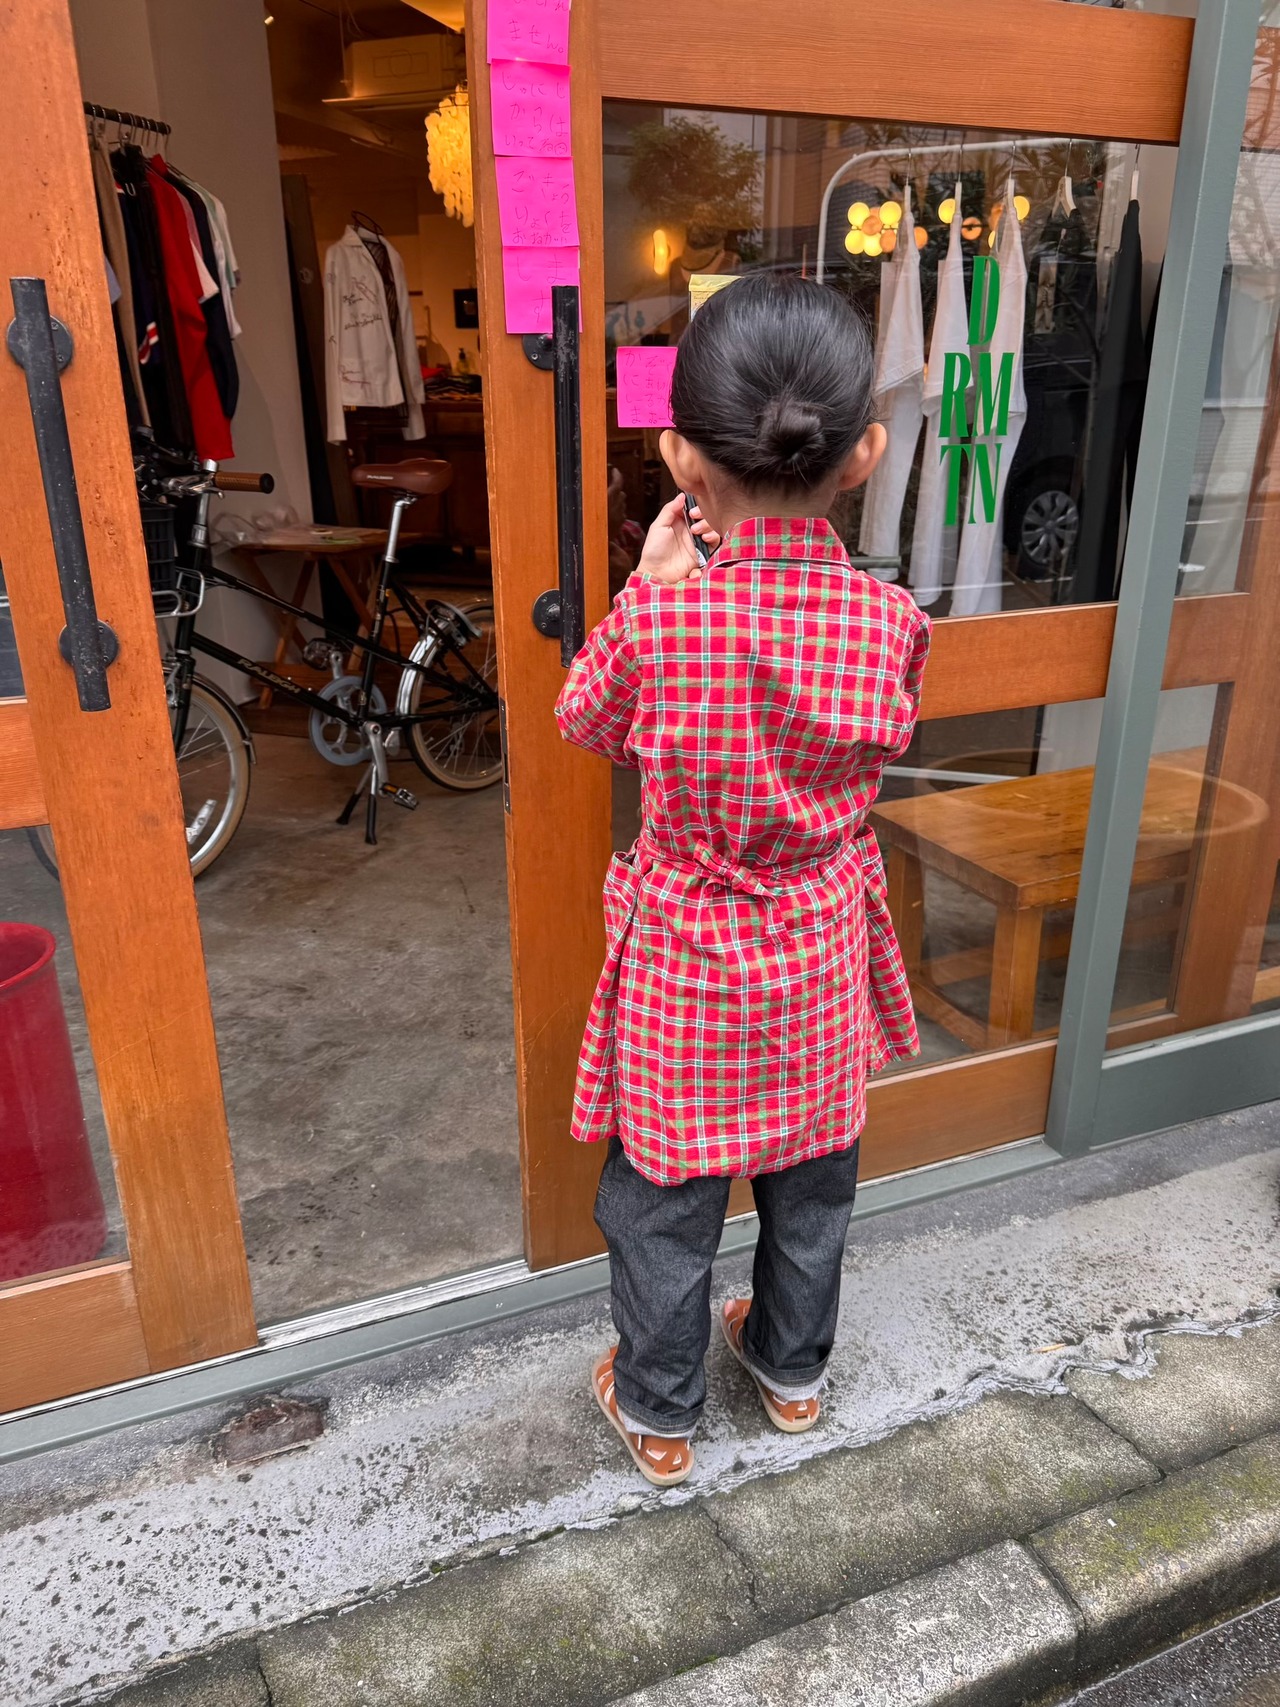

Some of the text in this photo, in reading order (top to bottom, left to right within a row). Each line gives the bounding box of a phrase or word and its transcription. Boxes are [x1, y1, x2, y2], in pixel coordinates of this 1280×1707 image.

[967, 255, 1000, 345] D
[938, 352, 1015, 438] RM
[940, 443, 1002, 526] TN
